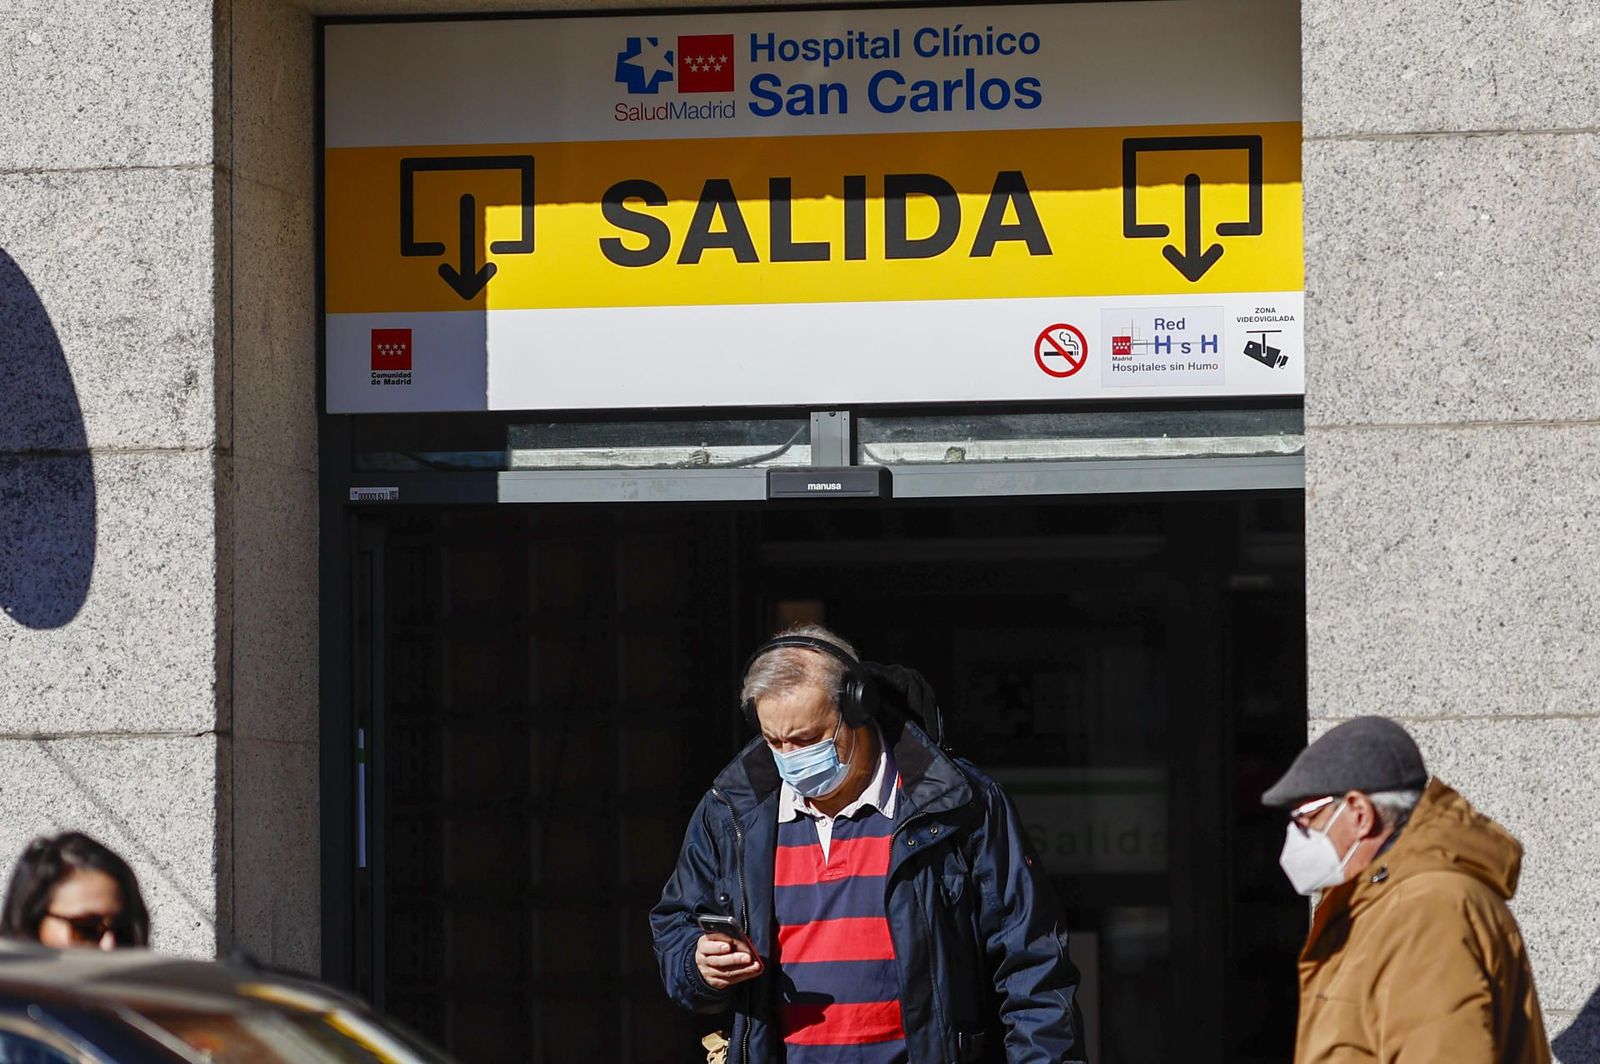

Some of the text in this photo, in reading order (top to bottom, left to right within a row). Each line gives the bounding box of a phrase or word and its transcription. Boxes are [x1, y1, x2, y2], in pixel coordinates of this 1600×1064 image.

[749, 24, 1041, 67] Hospital Clínico
[748, 68, 1043, 117] San Carlos
[614, 101, 735, 122] SaludMadrid
[599, 170, 1054, 268] SALIDA
[1154, 318, 1186, 331] Red
[1236, 315, 1295, 324] VIDEOVIGILADA
[1154, 335, 1171, 355] H
[1201, 334, 1218, 354] H
[371, 371, 412, 379] Comunidad
[1112, 361, 1219, 374] Hospitales sin Humo
[807, 482, 842, 491] manusa
